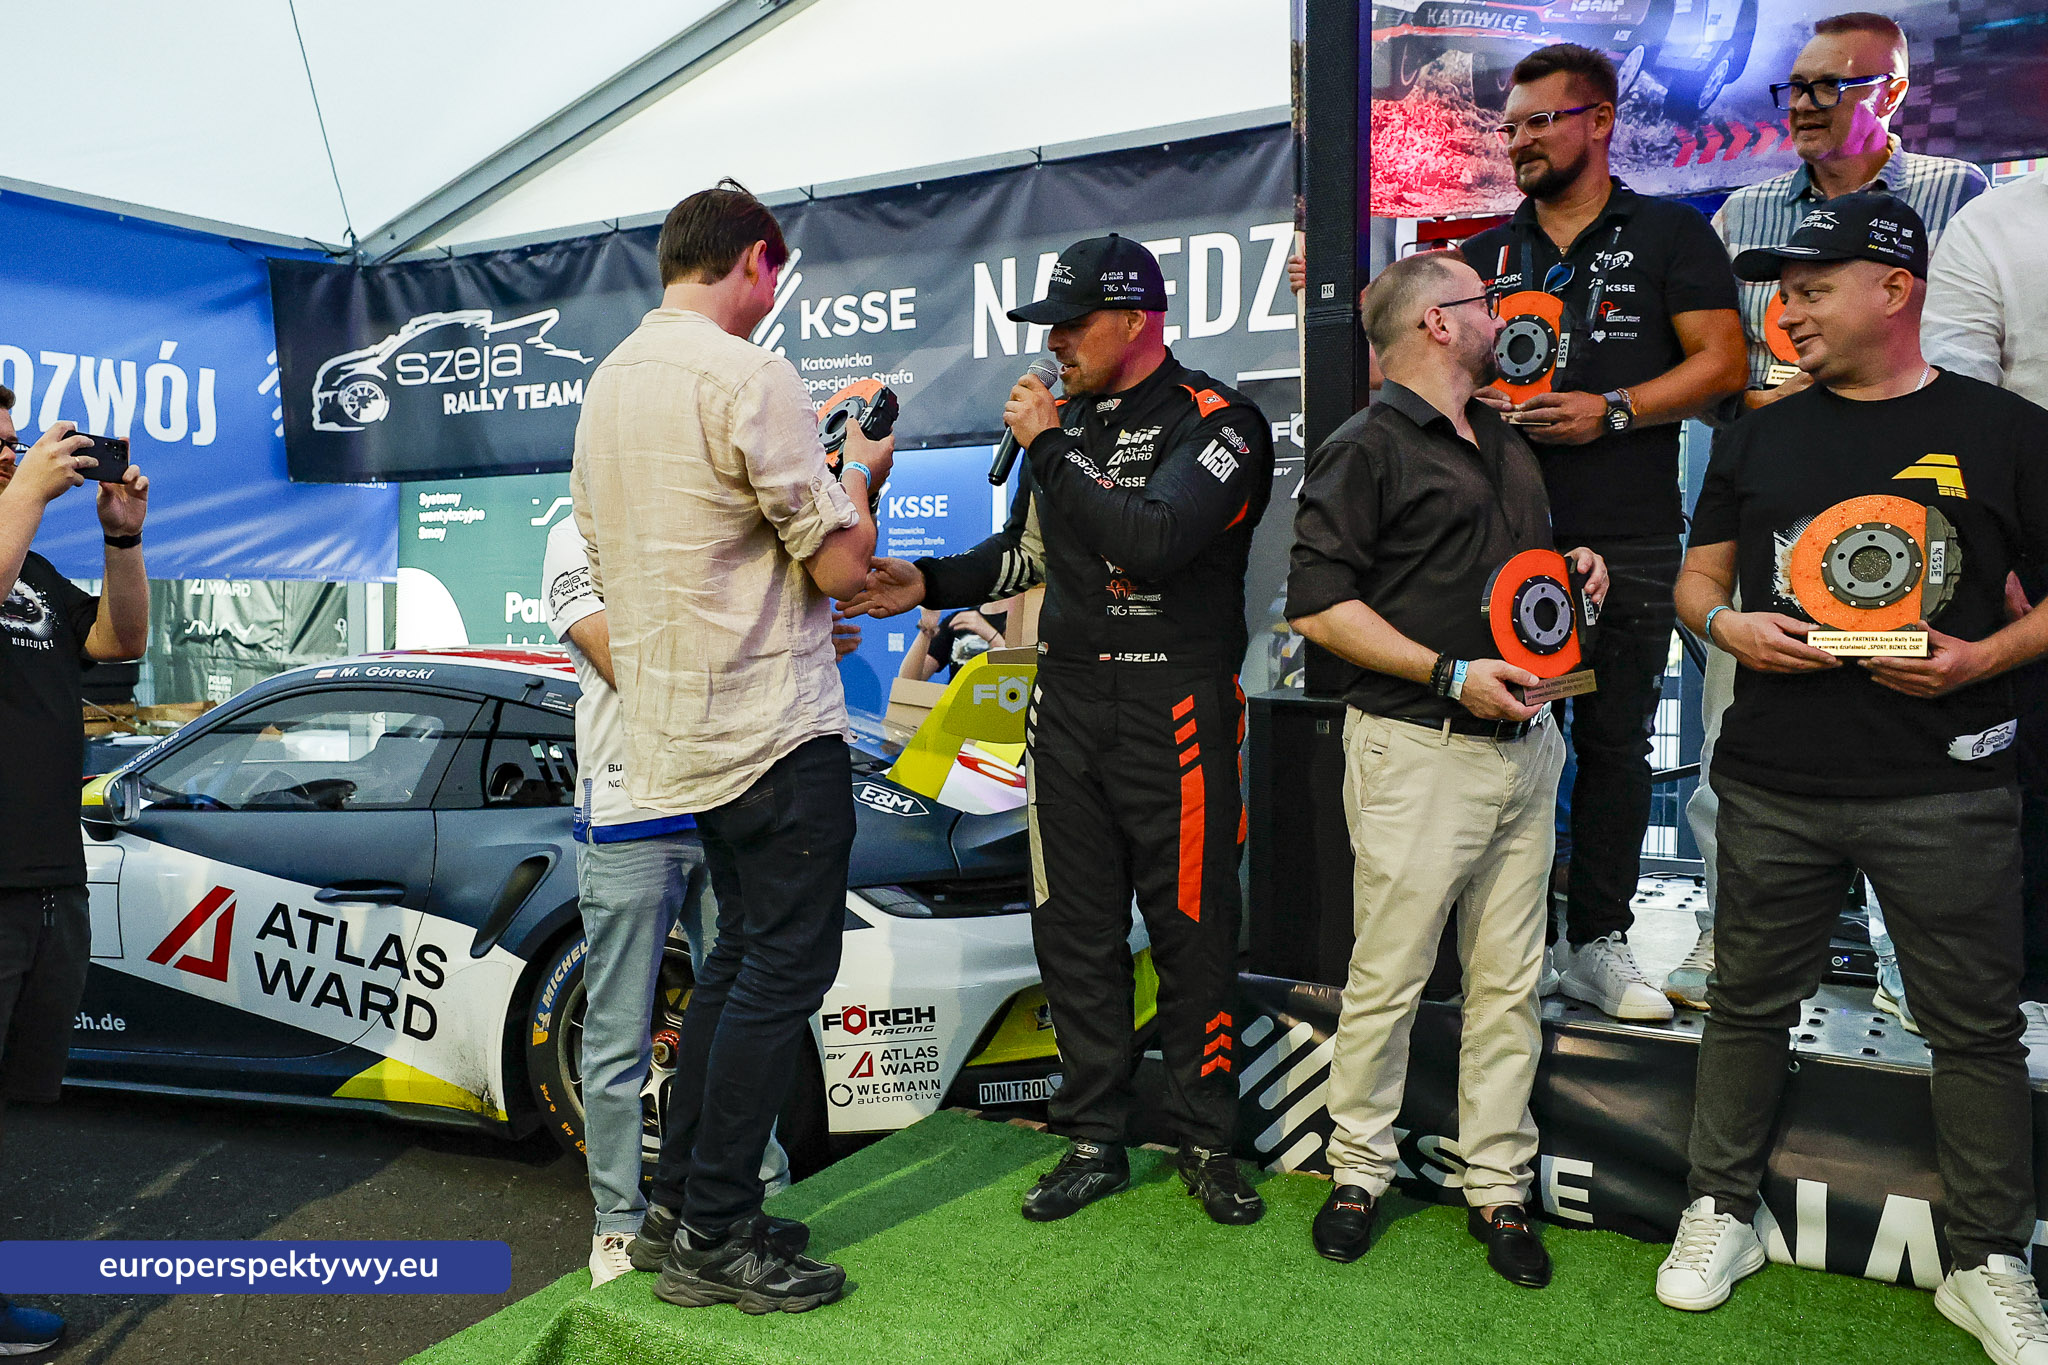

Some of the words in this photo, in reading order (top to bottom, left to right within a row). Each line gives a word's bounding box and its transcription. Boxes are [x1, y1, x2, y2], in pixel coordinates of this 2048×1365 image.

[1427, 8, 1528, 31] KATOWICE
[1484, 272, 1523, 286] KFOR
[973, 221, 1298, 359] NAĘDZ
[1605, 284, 1636, 293] KSSE
[800, 287, 918, 341] KSSE
[1558, 338, 1568, 363] KSSE
[395, 332, 523, 389] szeja
[801, 352, 873, 372] Katowicka
[871, 369, 914, 387] Strefa
[443, 386, 509, 415] RALLY
[513, 378, 584, 410] TEAM
[418, 492, 462, 508] Systemy
[888, 494, 949, 519] KSSE
[418, 526, 447, 542] Smay
[208, 581, 251, 598] WARD
[1114, 652, 1168, 663] J.SZEJA
[365, 666, 435, 680] Górecki
[254, 902, 448, 990] ATLAS
[254, 950, 438, 1042] WARD
[871, 1024, 935, 1037] RACING
[825, 1052, 847, 1061] BY
[880, 1046, 939, 1062] ATLAS
[880, 1061, 940, 1077] WARD
[857, 1079, 942, 1097] WEGMANN
[980, 1079, 1050, 1104] DINITROL
[857, 1091, 942, 1106] automotive
